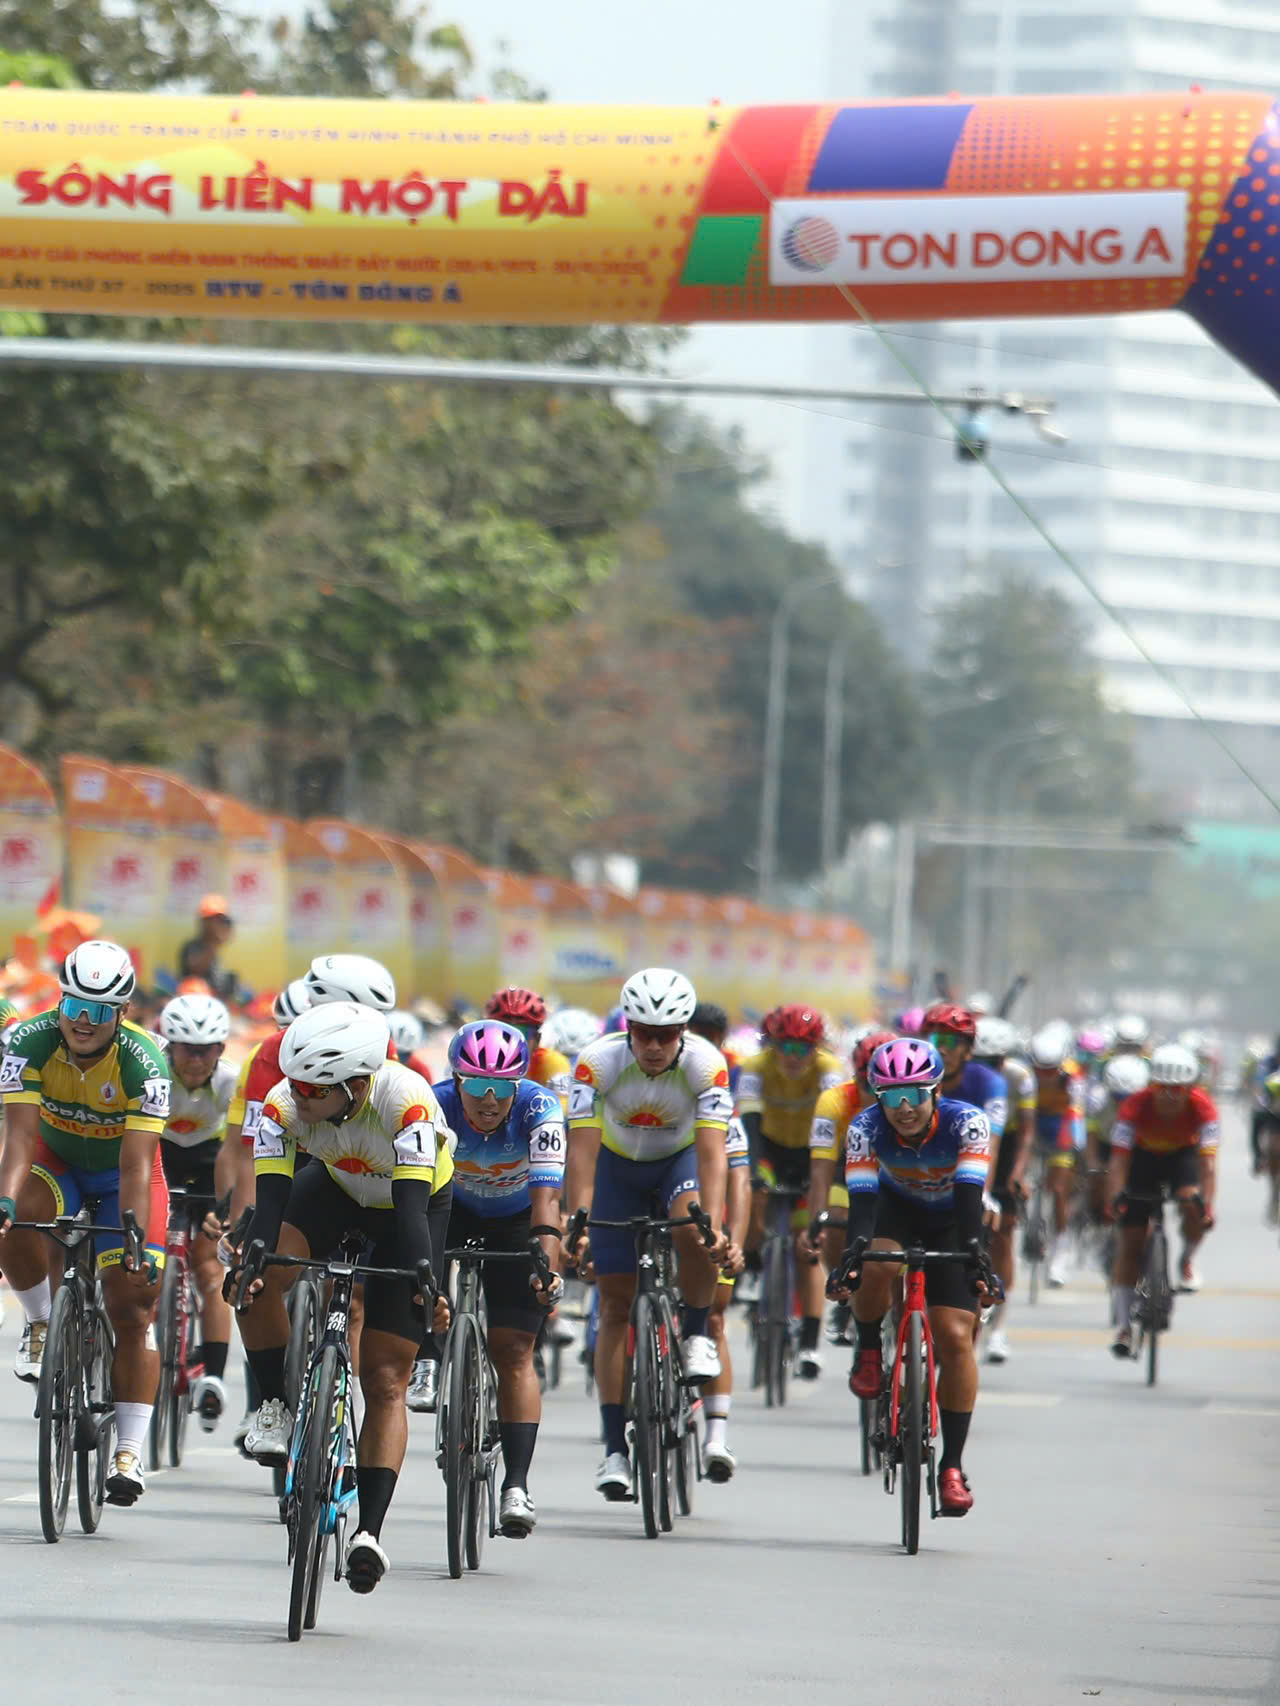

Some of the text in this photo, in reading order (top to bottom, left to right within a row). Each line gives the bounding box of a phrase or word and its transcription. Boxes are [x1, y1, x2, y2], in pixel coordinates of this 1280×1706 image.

[14, 161, 173, 217] SÔNG
[199, 159, 313, 213] LIỀN
[339, 170, 468, 226] MỘT
[848, 226, 1173, 271] TON DONG A
[12, 1018, 61, 1046] DOMES
[119, 1033, 161, 1079] OMESCO
[412, 1130, 425, 1154] 1
[537, 1130, 561, 1152] 86
[969, 1119, 988, 1141] 83
